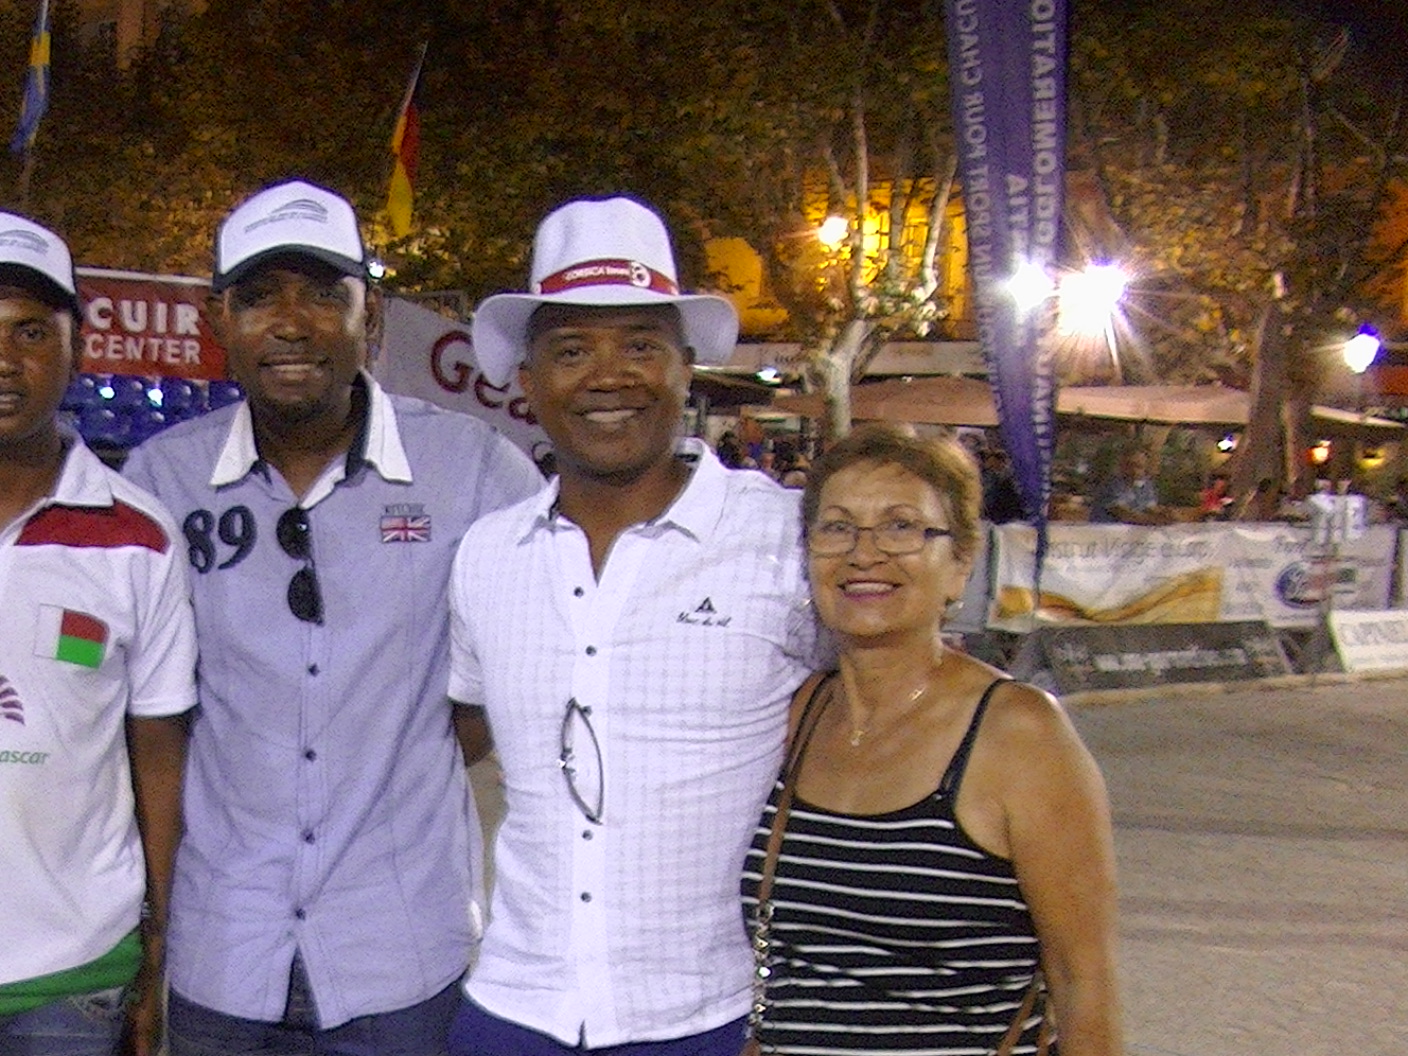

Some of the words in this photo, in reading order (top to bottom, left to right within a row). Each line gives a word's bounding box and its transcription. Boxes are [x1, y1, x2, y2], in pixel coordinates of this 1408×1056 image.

[88, 297, 200, 337] CUIR
[85, 333, 202, 366] CENTER
[183, 508, 257, 574] 89
